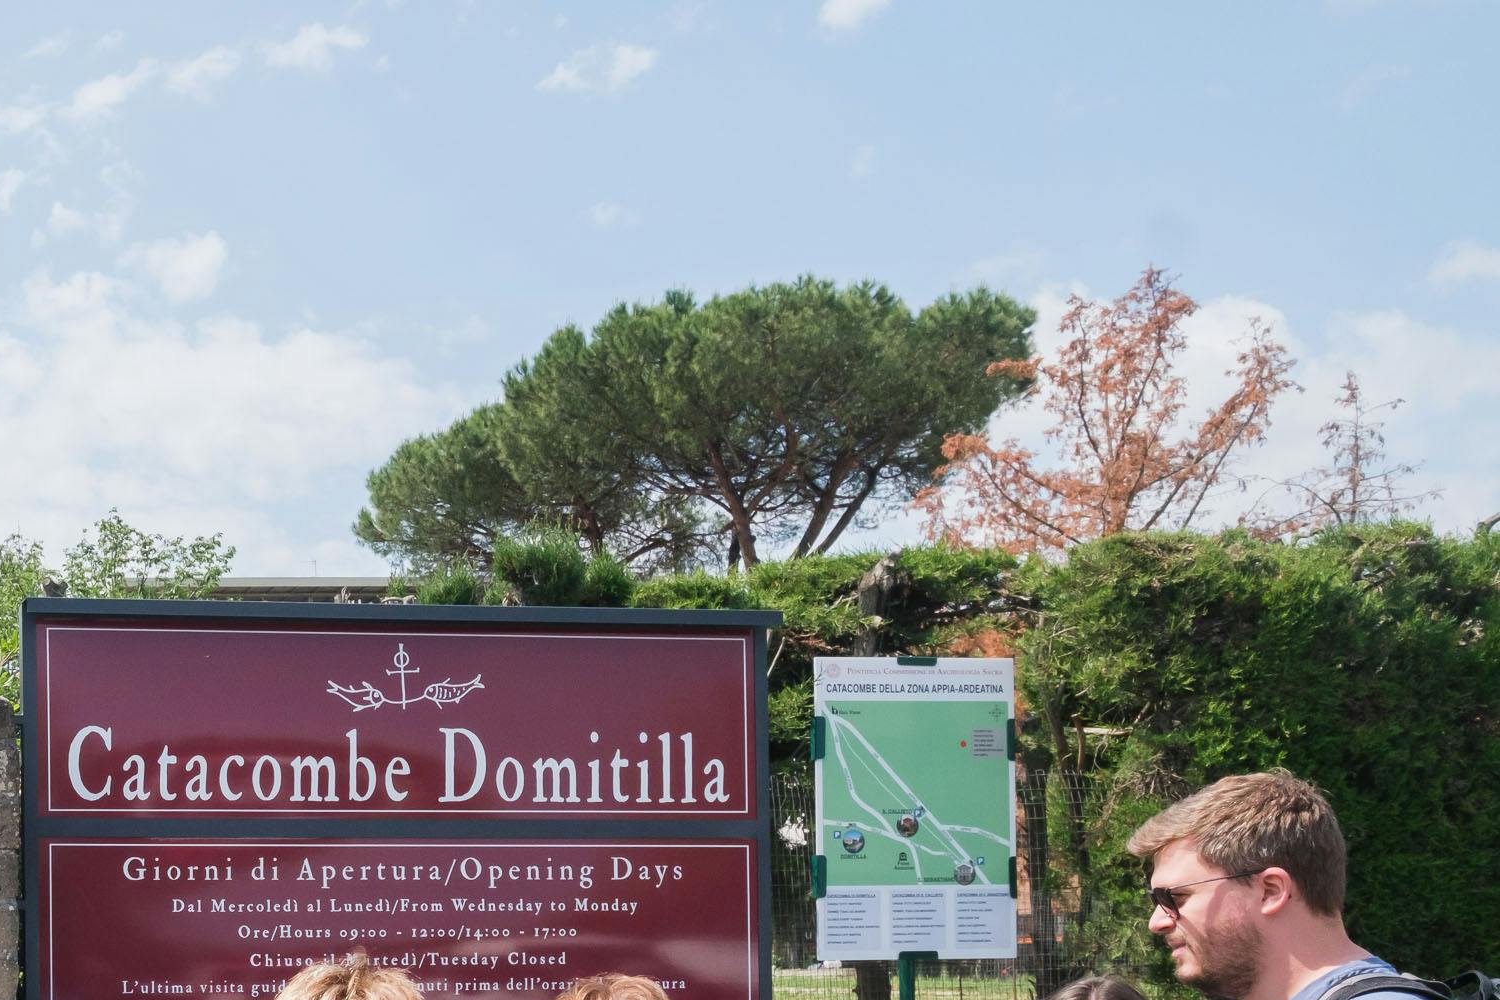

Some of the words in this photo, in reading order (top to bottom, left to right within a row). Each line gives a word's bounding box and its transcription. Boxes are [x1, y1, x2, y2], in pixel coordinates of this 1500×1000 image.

[826, 683, 876, 694] CATACOMBE
[879, 683, 906, 694] DELLA
[907, 683, 929, 694] ZONA
[931, 683, 1004, 694] APPIA-ARDEATINA
[67, 725, 411, 802] Catacombe
[438, 727, 730, 804] Domitilla
[122, 856, 233, 882] Giorni
[251, 856, 280, 882] di
[296, 856, 595, 889] Apertura/Opening
[611, 856, 684, 889] Days
[171, 898, 202, 913] Dal
[210, 898, 299, 913] Mercoledì
[307, 899, 321, 913] al
[329, 898, 444, 915] Lunedì/From
[450, 898, 543, 916] Wednesday
[550, 901, 567, 912] to
[574, 897, 639, 916] Monday
[237, 924, 332, 942] Ore/Hours
[339, 927, 388, 941] 09:00
[410, 924, 511, 942] 12:00/14:00
[534, 926, 578, 941] 17:00
[249, 953, 314, 967] Chiuso
[507, 951, 567, 966] Closed
[122, 980, 194, 995] L’ultima
[199, 980, 245, 994] visita
[251, 979, 287, 998] guid
[454, 977, 501, 996] prima
